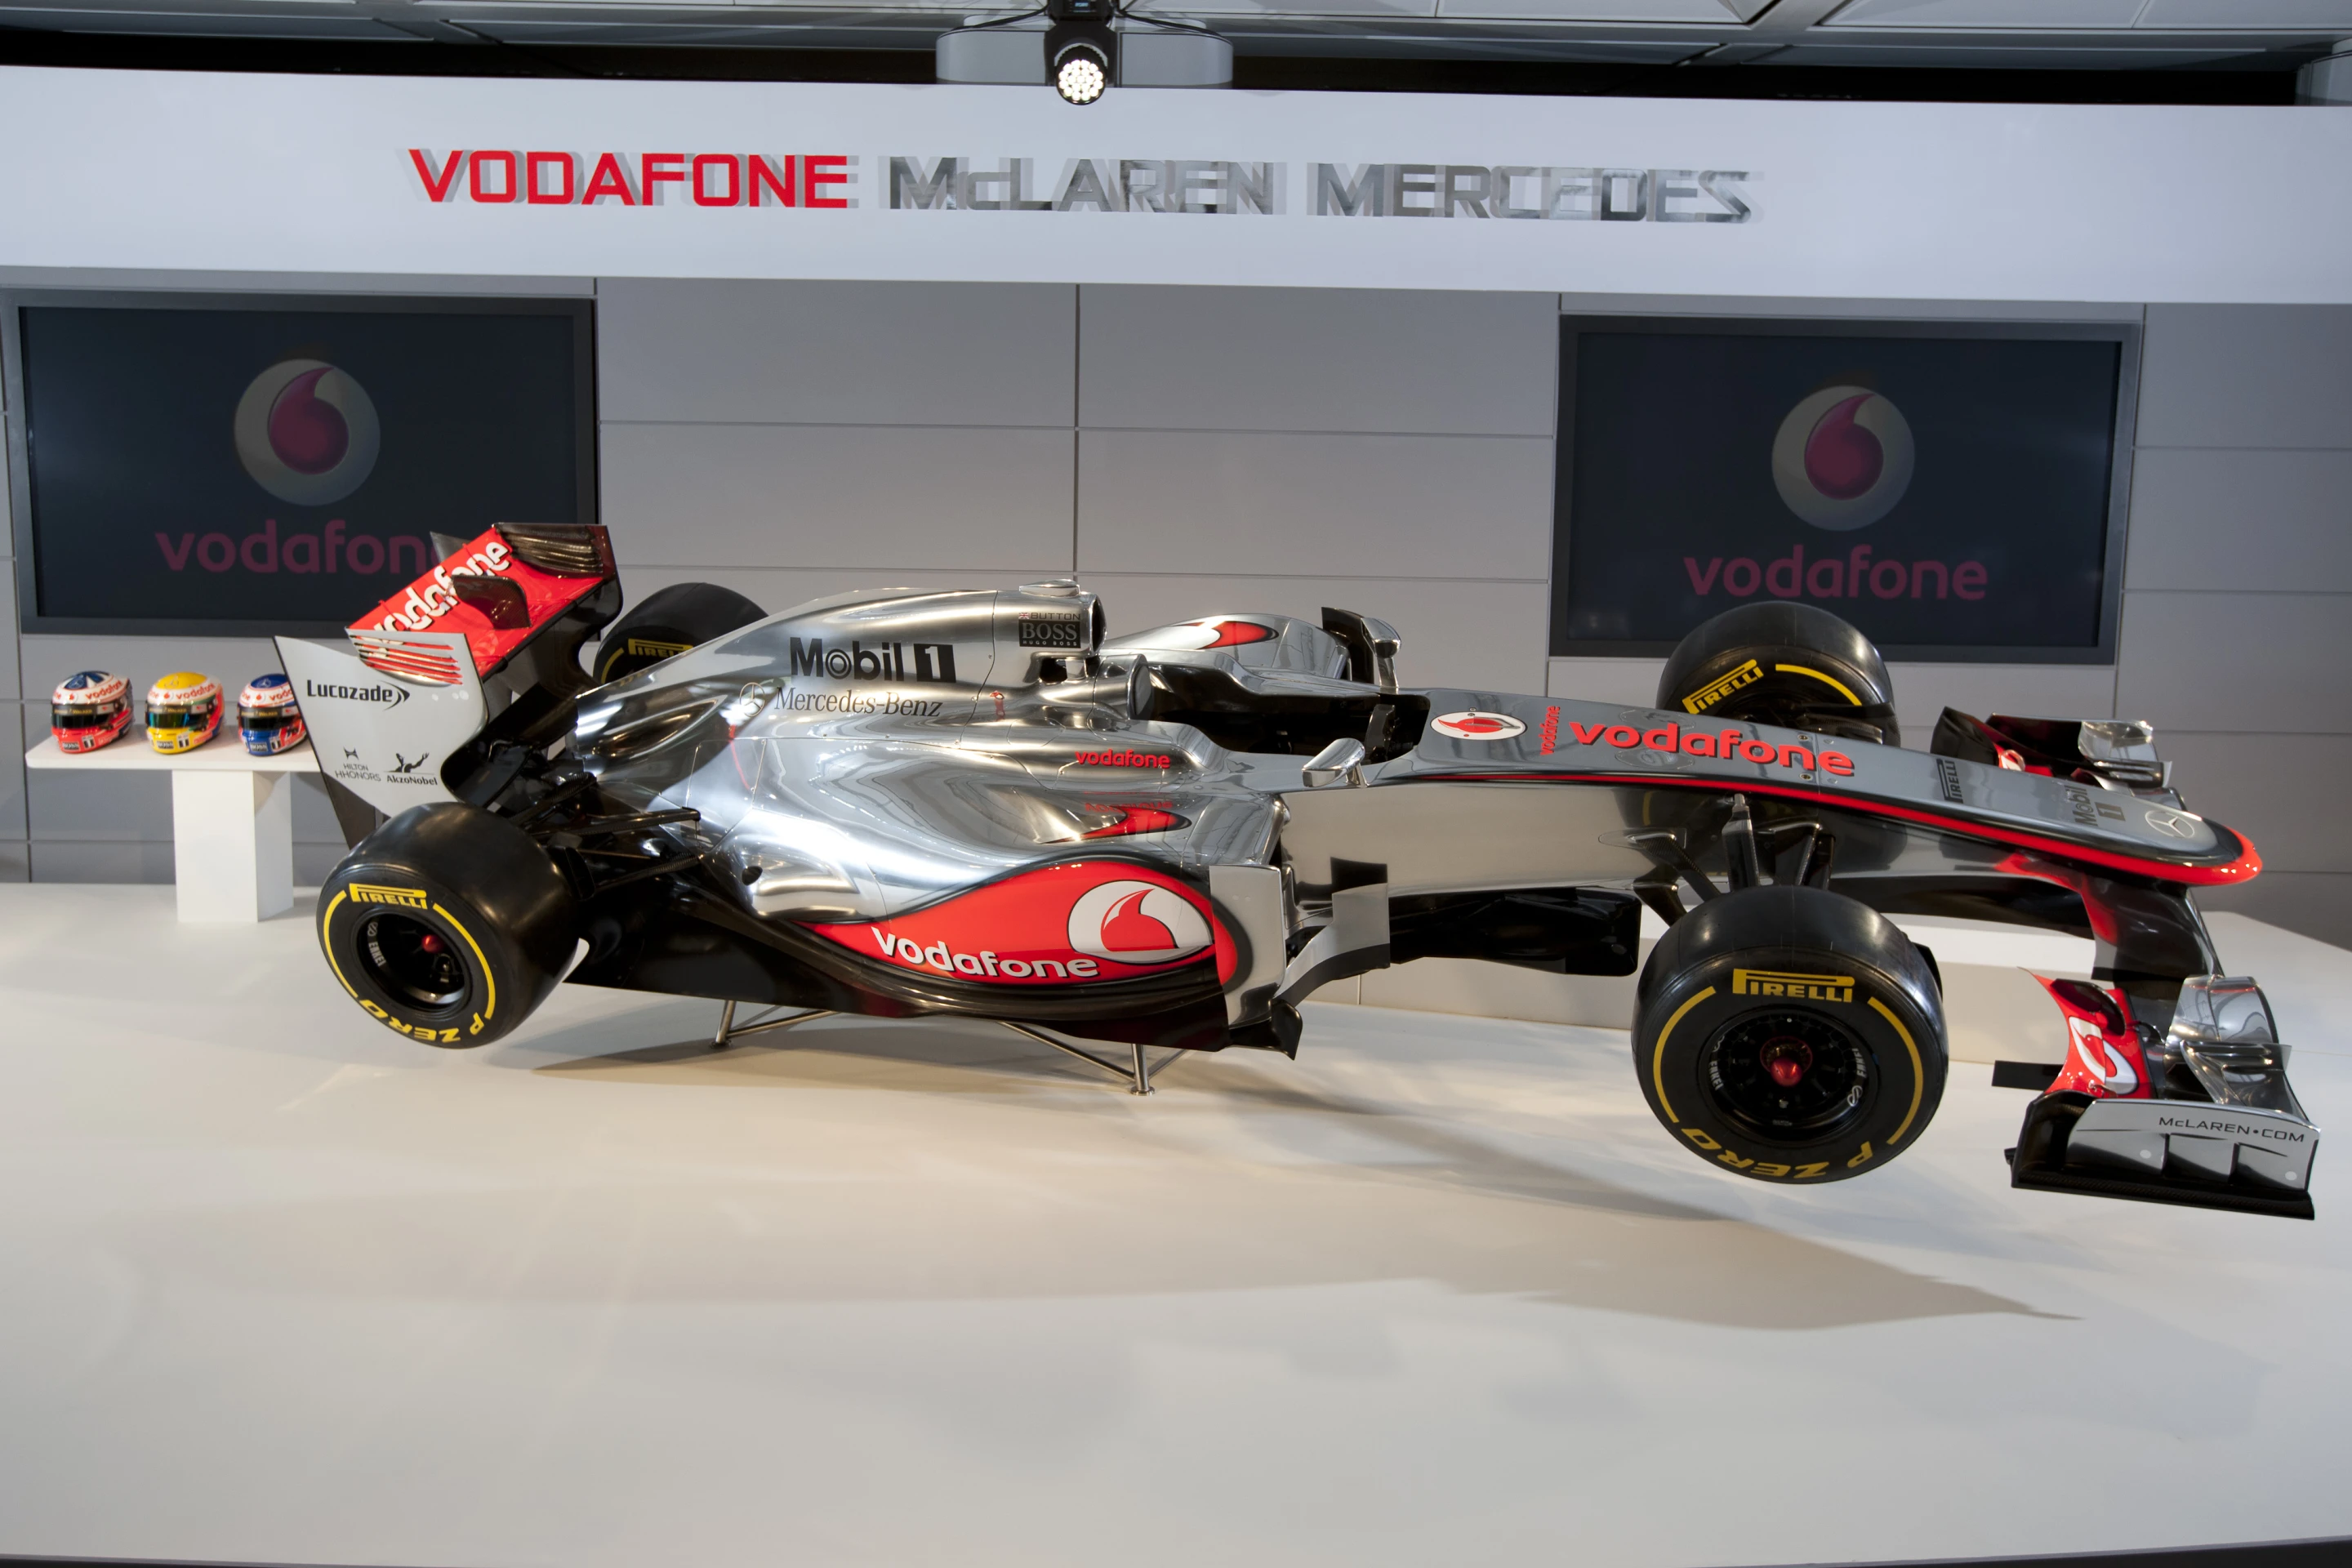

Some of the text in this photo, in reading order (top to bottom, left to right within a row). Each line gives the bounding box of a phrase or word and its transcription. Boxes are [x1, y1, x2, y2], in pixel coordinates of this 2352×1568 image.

[408, 148, 848, 209] VODAFONE
[1316, 162, 1752, 225] MERCEDES
[154, 519, 436, 574] vodafon
[1682, 544, 1988, 600] vodafone
[1022, 622, 1077, 640] BOSS
[1030, 612, 1081, 621] BUTTON
[790, 637, 904, 681] Mobil
[306, 679, 393, 702] Lucozade
[774, 687, 943, 717] Mercedes-Benz
[1682, 659, 1764, 715] PIRELLI
[1538, 706, 1561, 756] vodafone
[1568, 720, 1855, 777] vodafone
[335, 770, 381, 782] HHONORS
[343, 764, 369, 772] HILTON
[1075, 748, 1171, 768] vodafone
[386, 775, 439, 786] AkzoNobel
[1936, 758, 1964, 804] PIRELLI
[349, 883, 428, 910] PIRELLI
[871, 925, 1099, 978] vodafone
[1732, 968, 1855, 1003] PIRELLI
[359, 999, 461, 1043] ZERO
[1681, 1128, 1874, 1179] P ZERO
